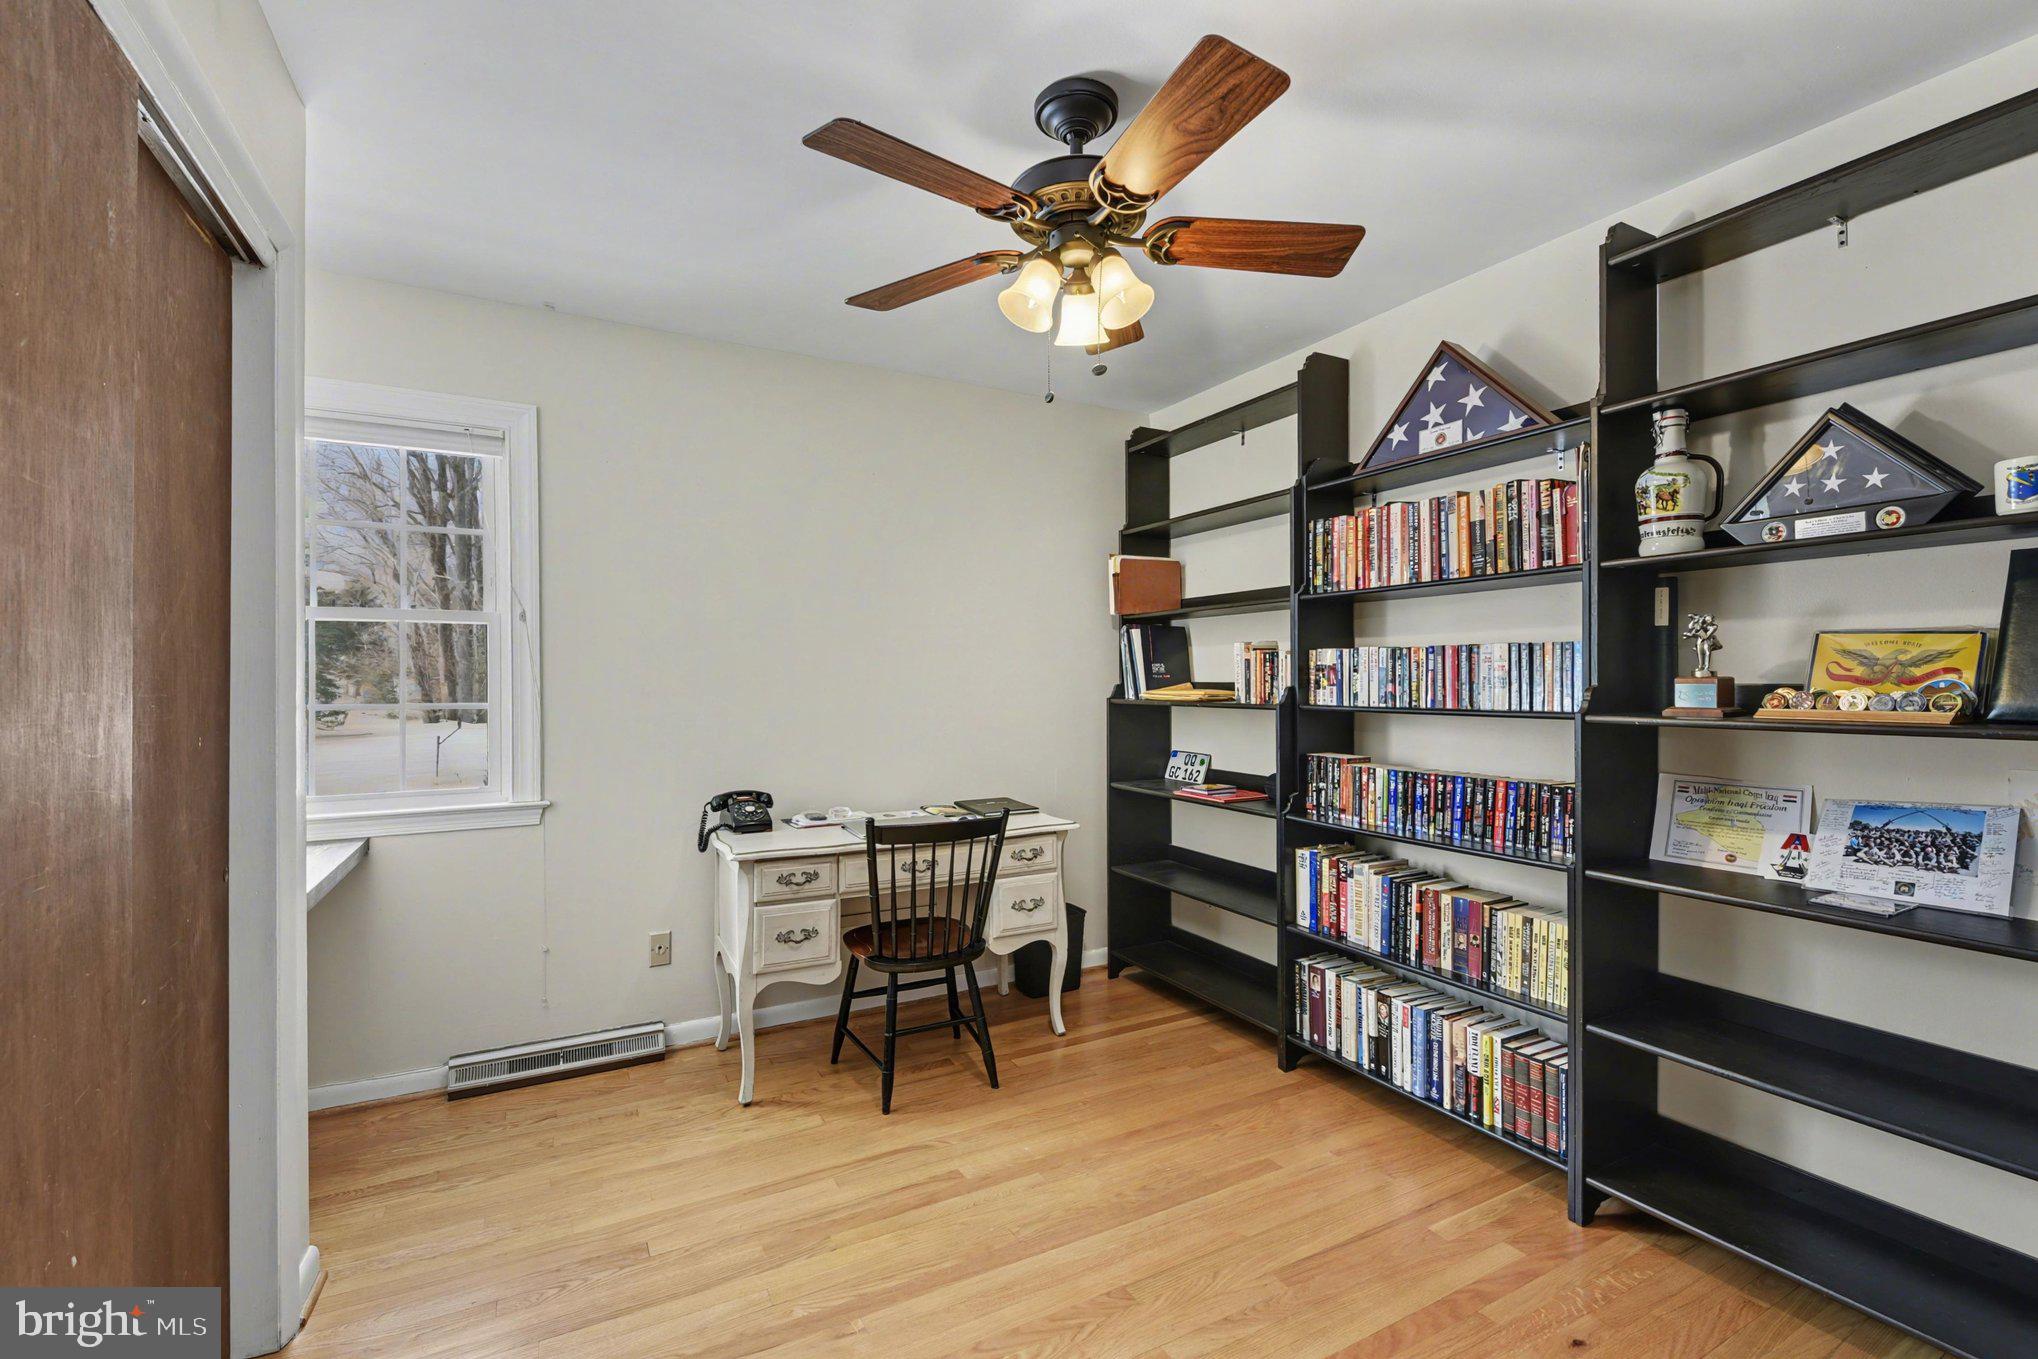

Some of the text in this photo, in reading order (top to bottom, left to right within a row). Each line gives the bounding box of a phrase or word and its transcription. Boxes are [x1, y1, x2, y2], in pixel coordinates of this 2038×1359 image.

[1168, 765, 1201, 782] GC 162
[1685, 795, 1725, 805] Operation
[1750, 801, 1788, 812] Freedom
